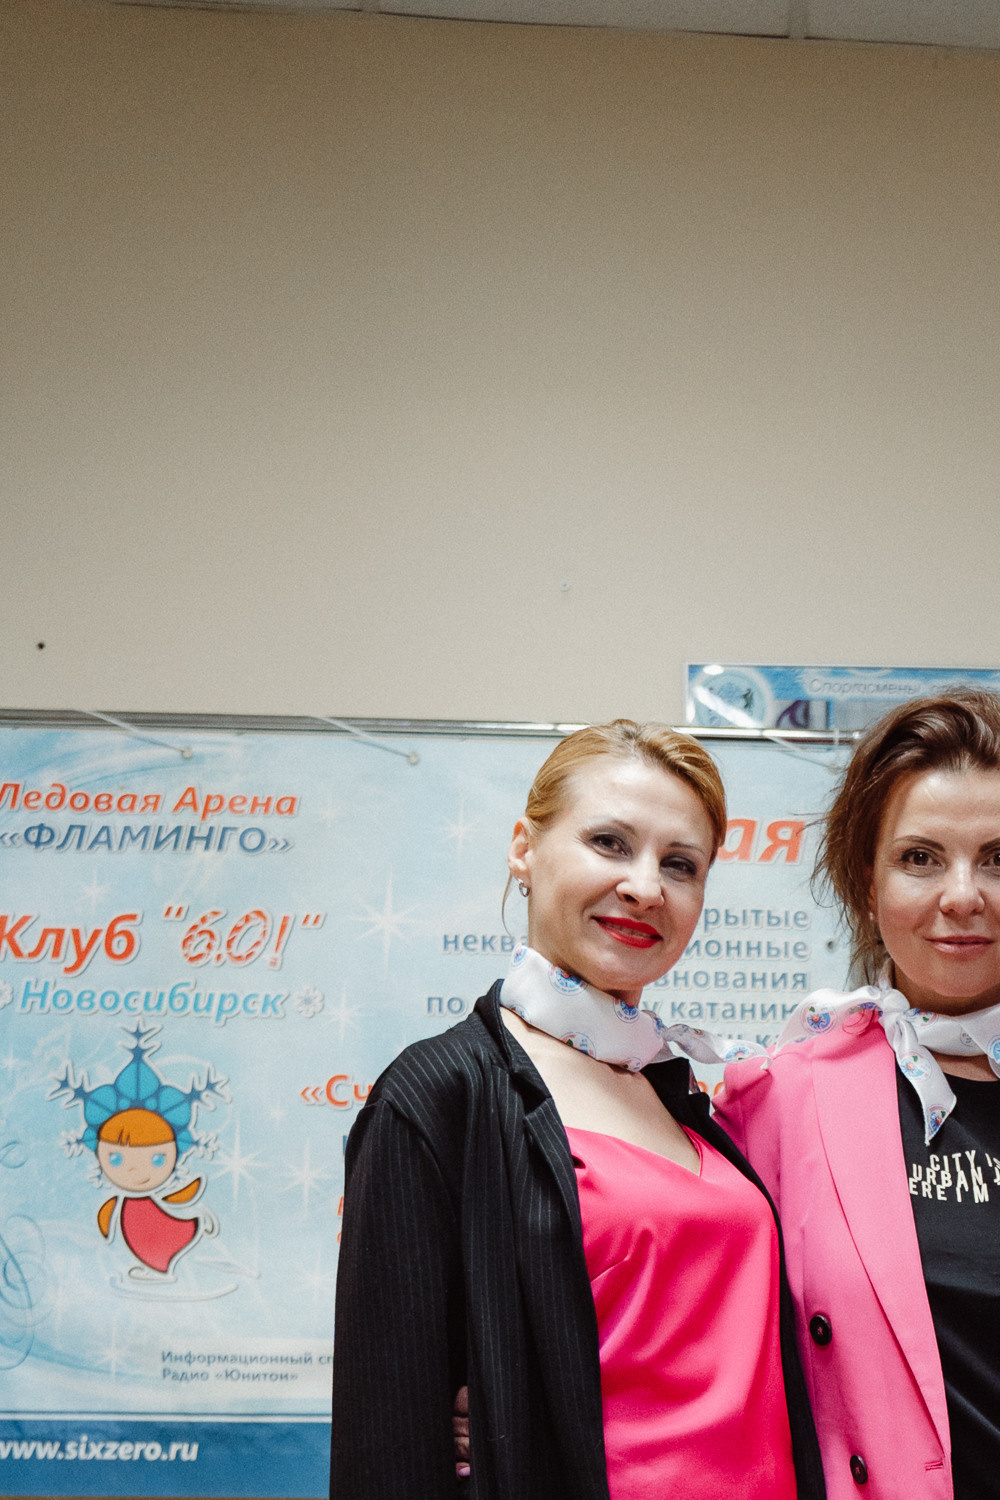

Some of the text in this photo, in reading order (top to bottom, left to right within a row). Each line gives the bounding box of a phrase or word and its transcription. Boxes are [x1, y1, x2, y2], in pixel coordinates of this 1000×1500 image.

[0, 783, 297, 821] Ледовая Арена
[0, 823, 293, 852] «ФЛАМИНГО»
[0, 914, 138, 974] Клуб
[20, 981, 284, 1022] Новосибирск
[427, 996, 465, 1015] по
[929, 1150, 976, 1173] CITY
[912, 1163, 984, 1193] URBAN
[161, 1351, 313, 1366] Информационный
[162, 1368, 209, 1382] Радио
